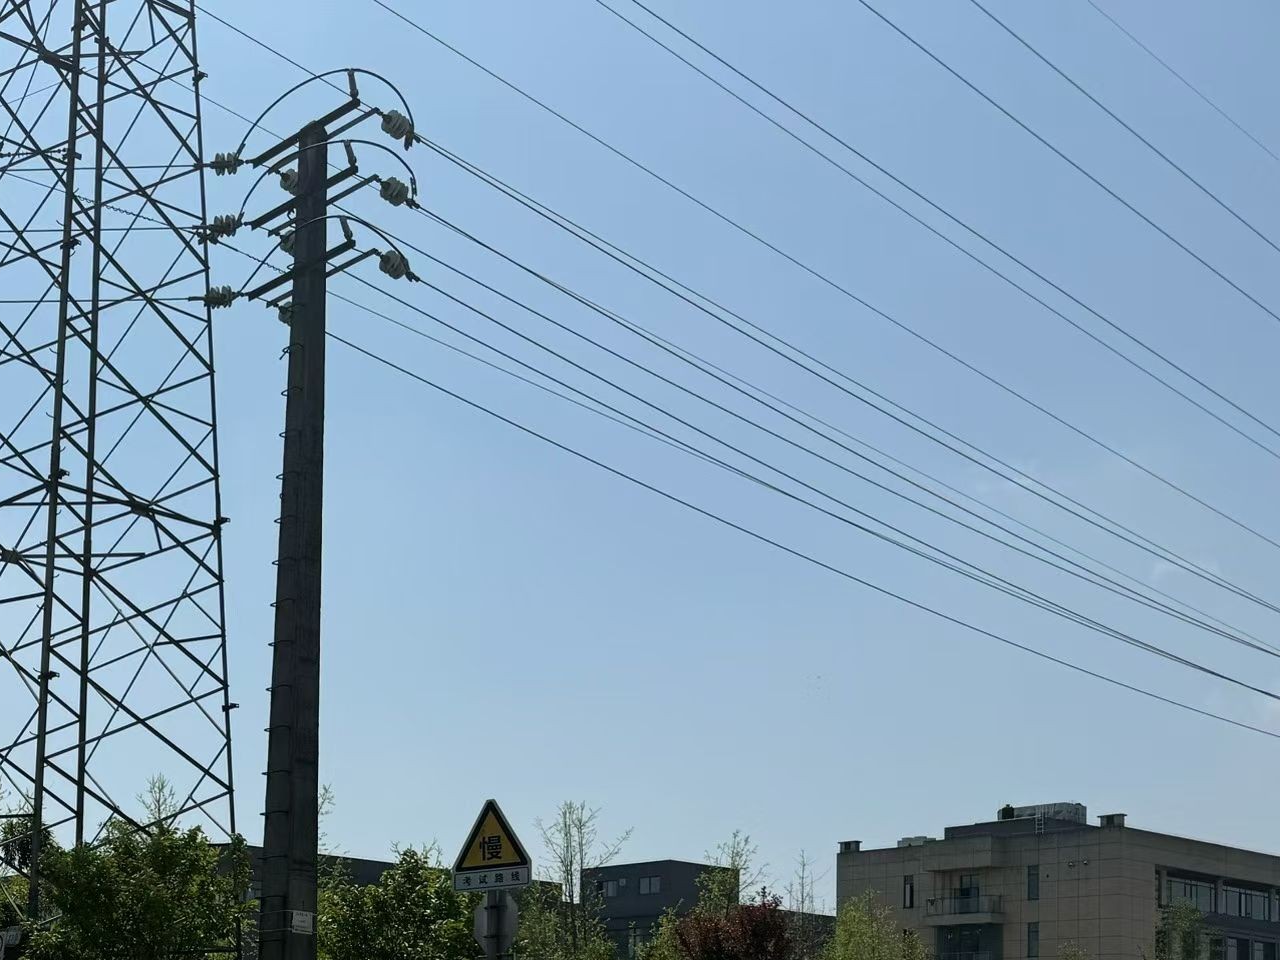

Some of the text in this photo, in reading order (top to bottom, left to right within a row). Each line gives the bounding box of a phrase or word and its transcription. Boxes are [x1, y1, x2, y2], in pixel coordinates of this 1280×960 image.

[479, 835, 503, 861] 慢
[462, 871, 521, 887] 考试路线
